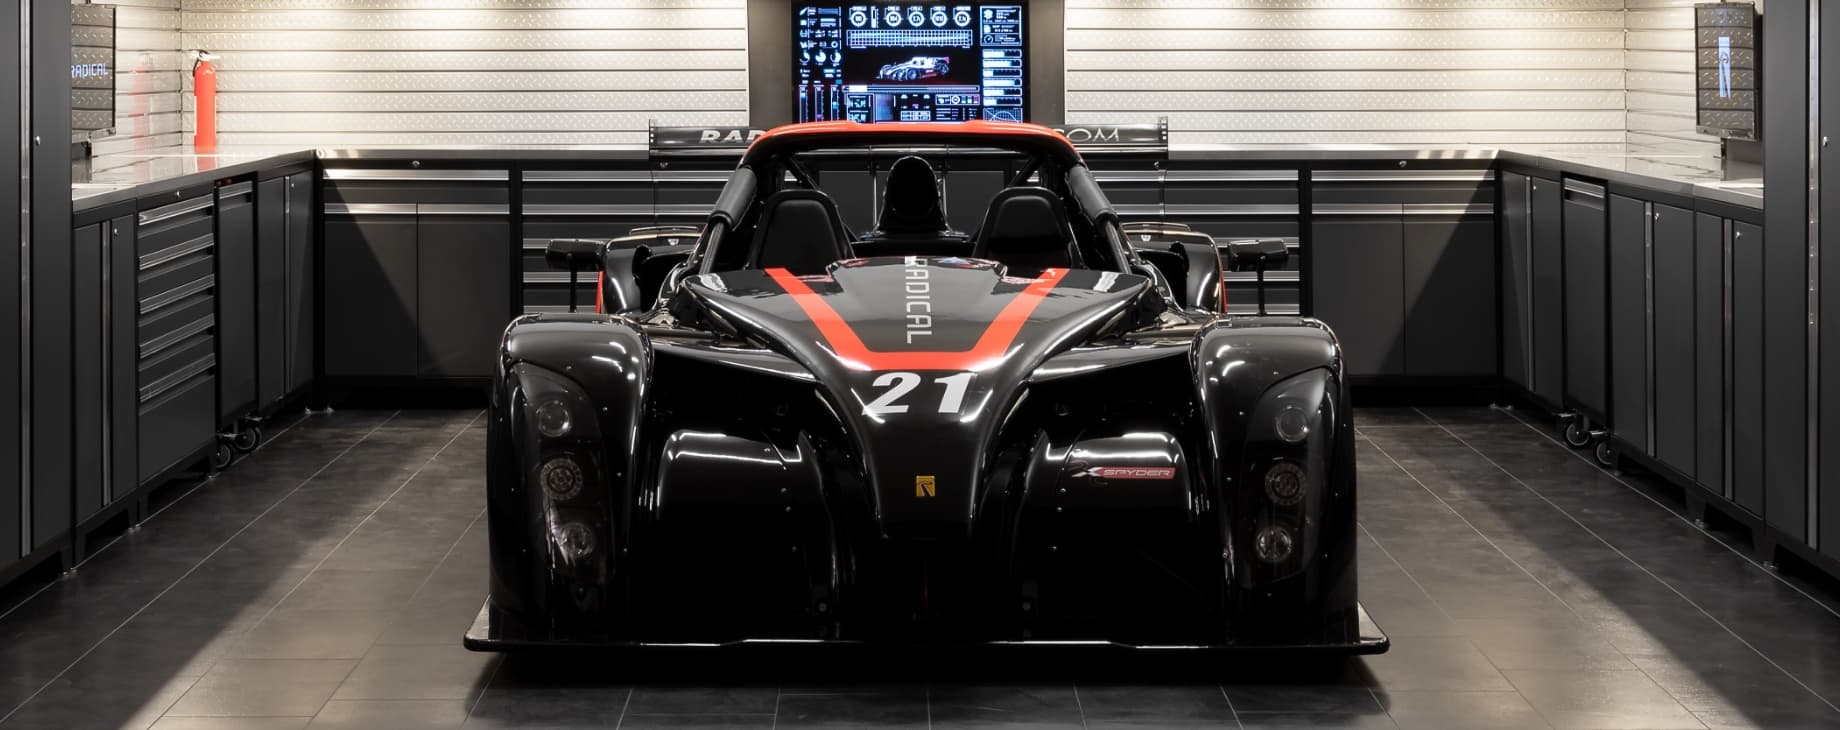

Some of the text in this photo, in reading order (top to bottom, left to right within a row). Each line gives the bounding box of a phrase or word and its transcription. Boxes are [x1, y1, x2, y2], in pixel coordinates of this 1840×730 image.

[71, 63, 108, 78] RADICAL
[905, 258, 932, 344] RADICAL
[861, 371, 978, 415] 21
